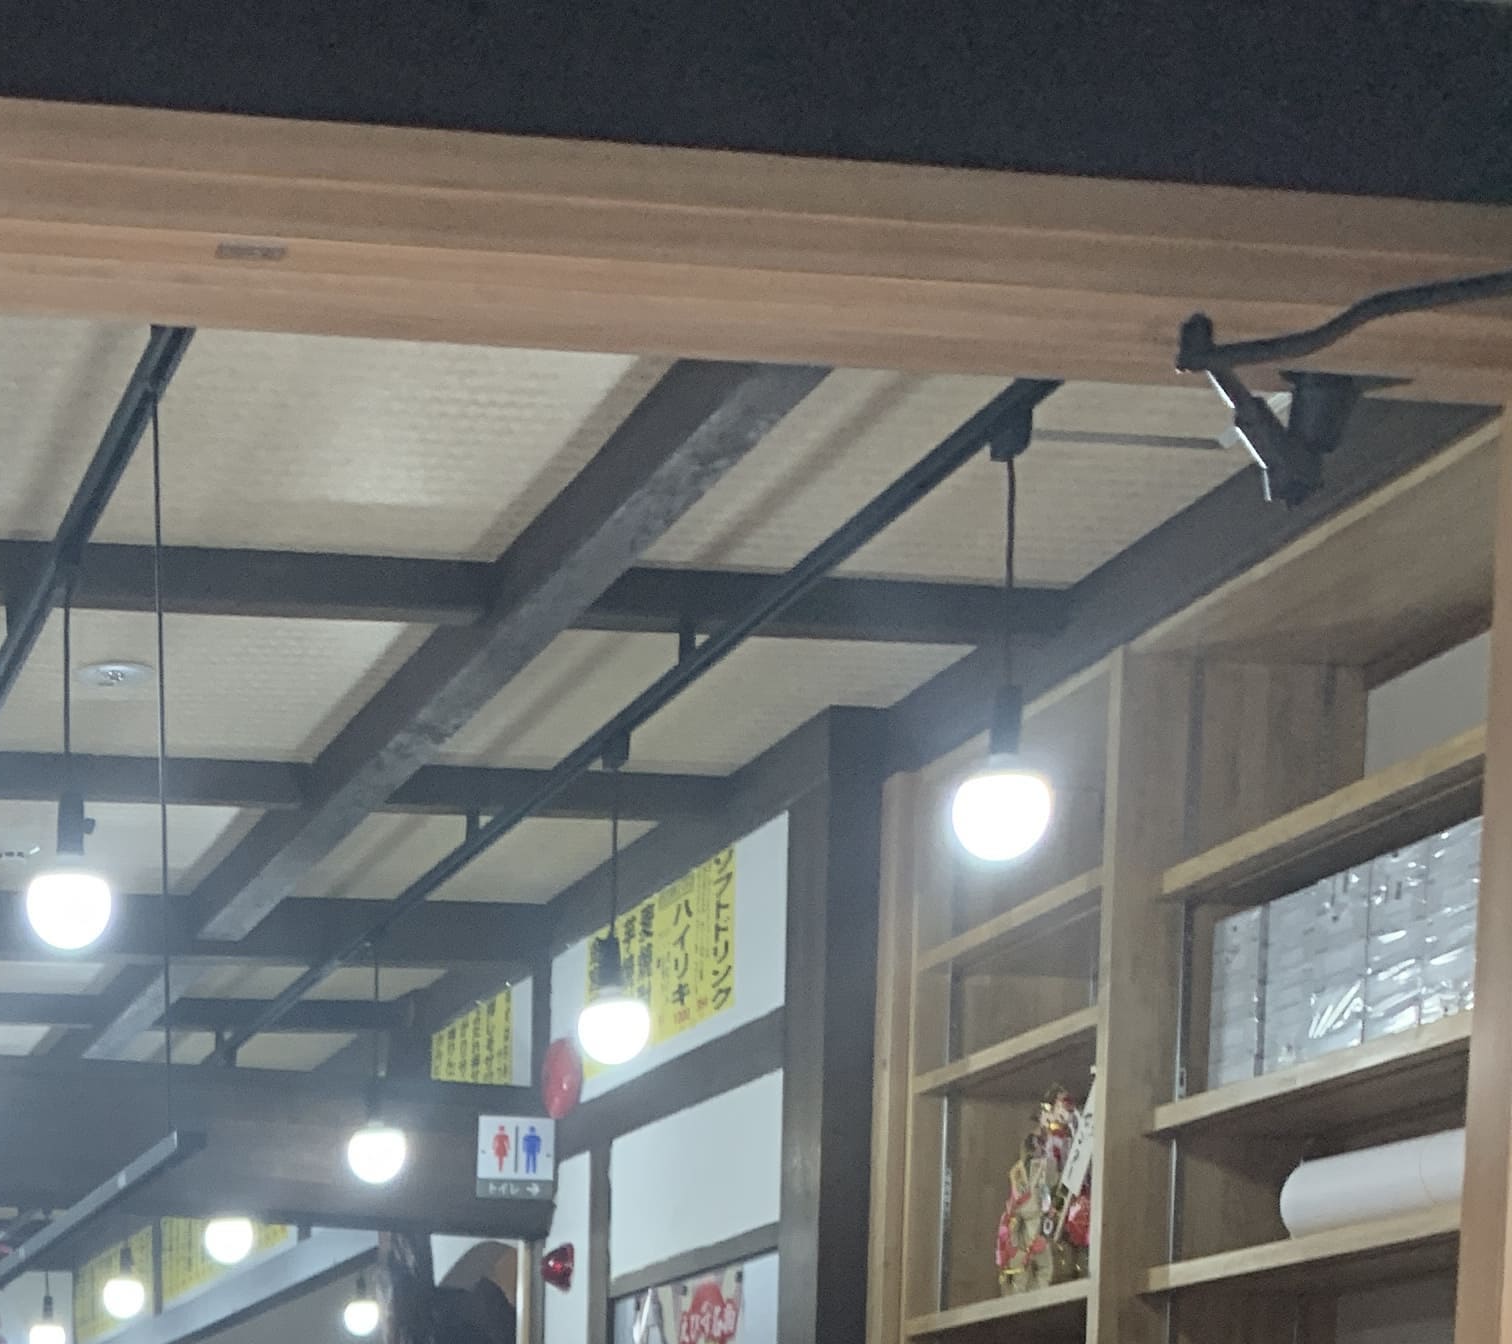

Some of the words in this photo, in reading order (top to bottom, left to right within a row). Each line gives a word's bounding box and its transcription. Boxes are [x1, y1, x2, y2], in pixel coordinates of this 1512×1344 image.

[672, 899, 693, 1007] ハイリキ
[711, 848, 734, 1011] ソフトドリンク
[487, 1182, 520, 1196] トイレ
